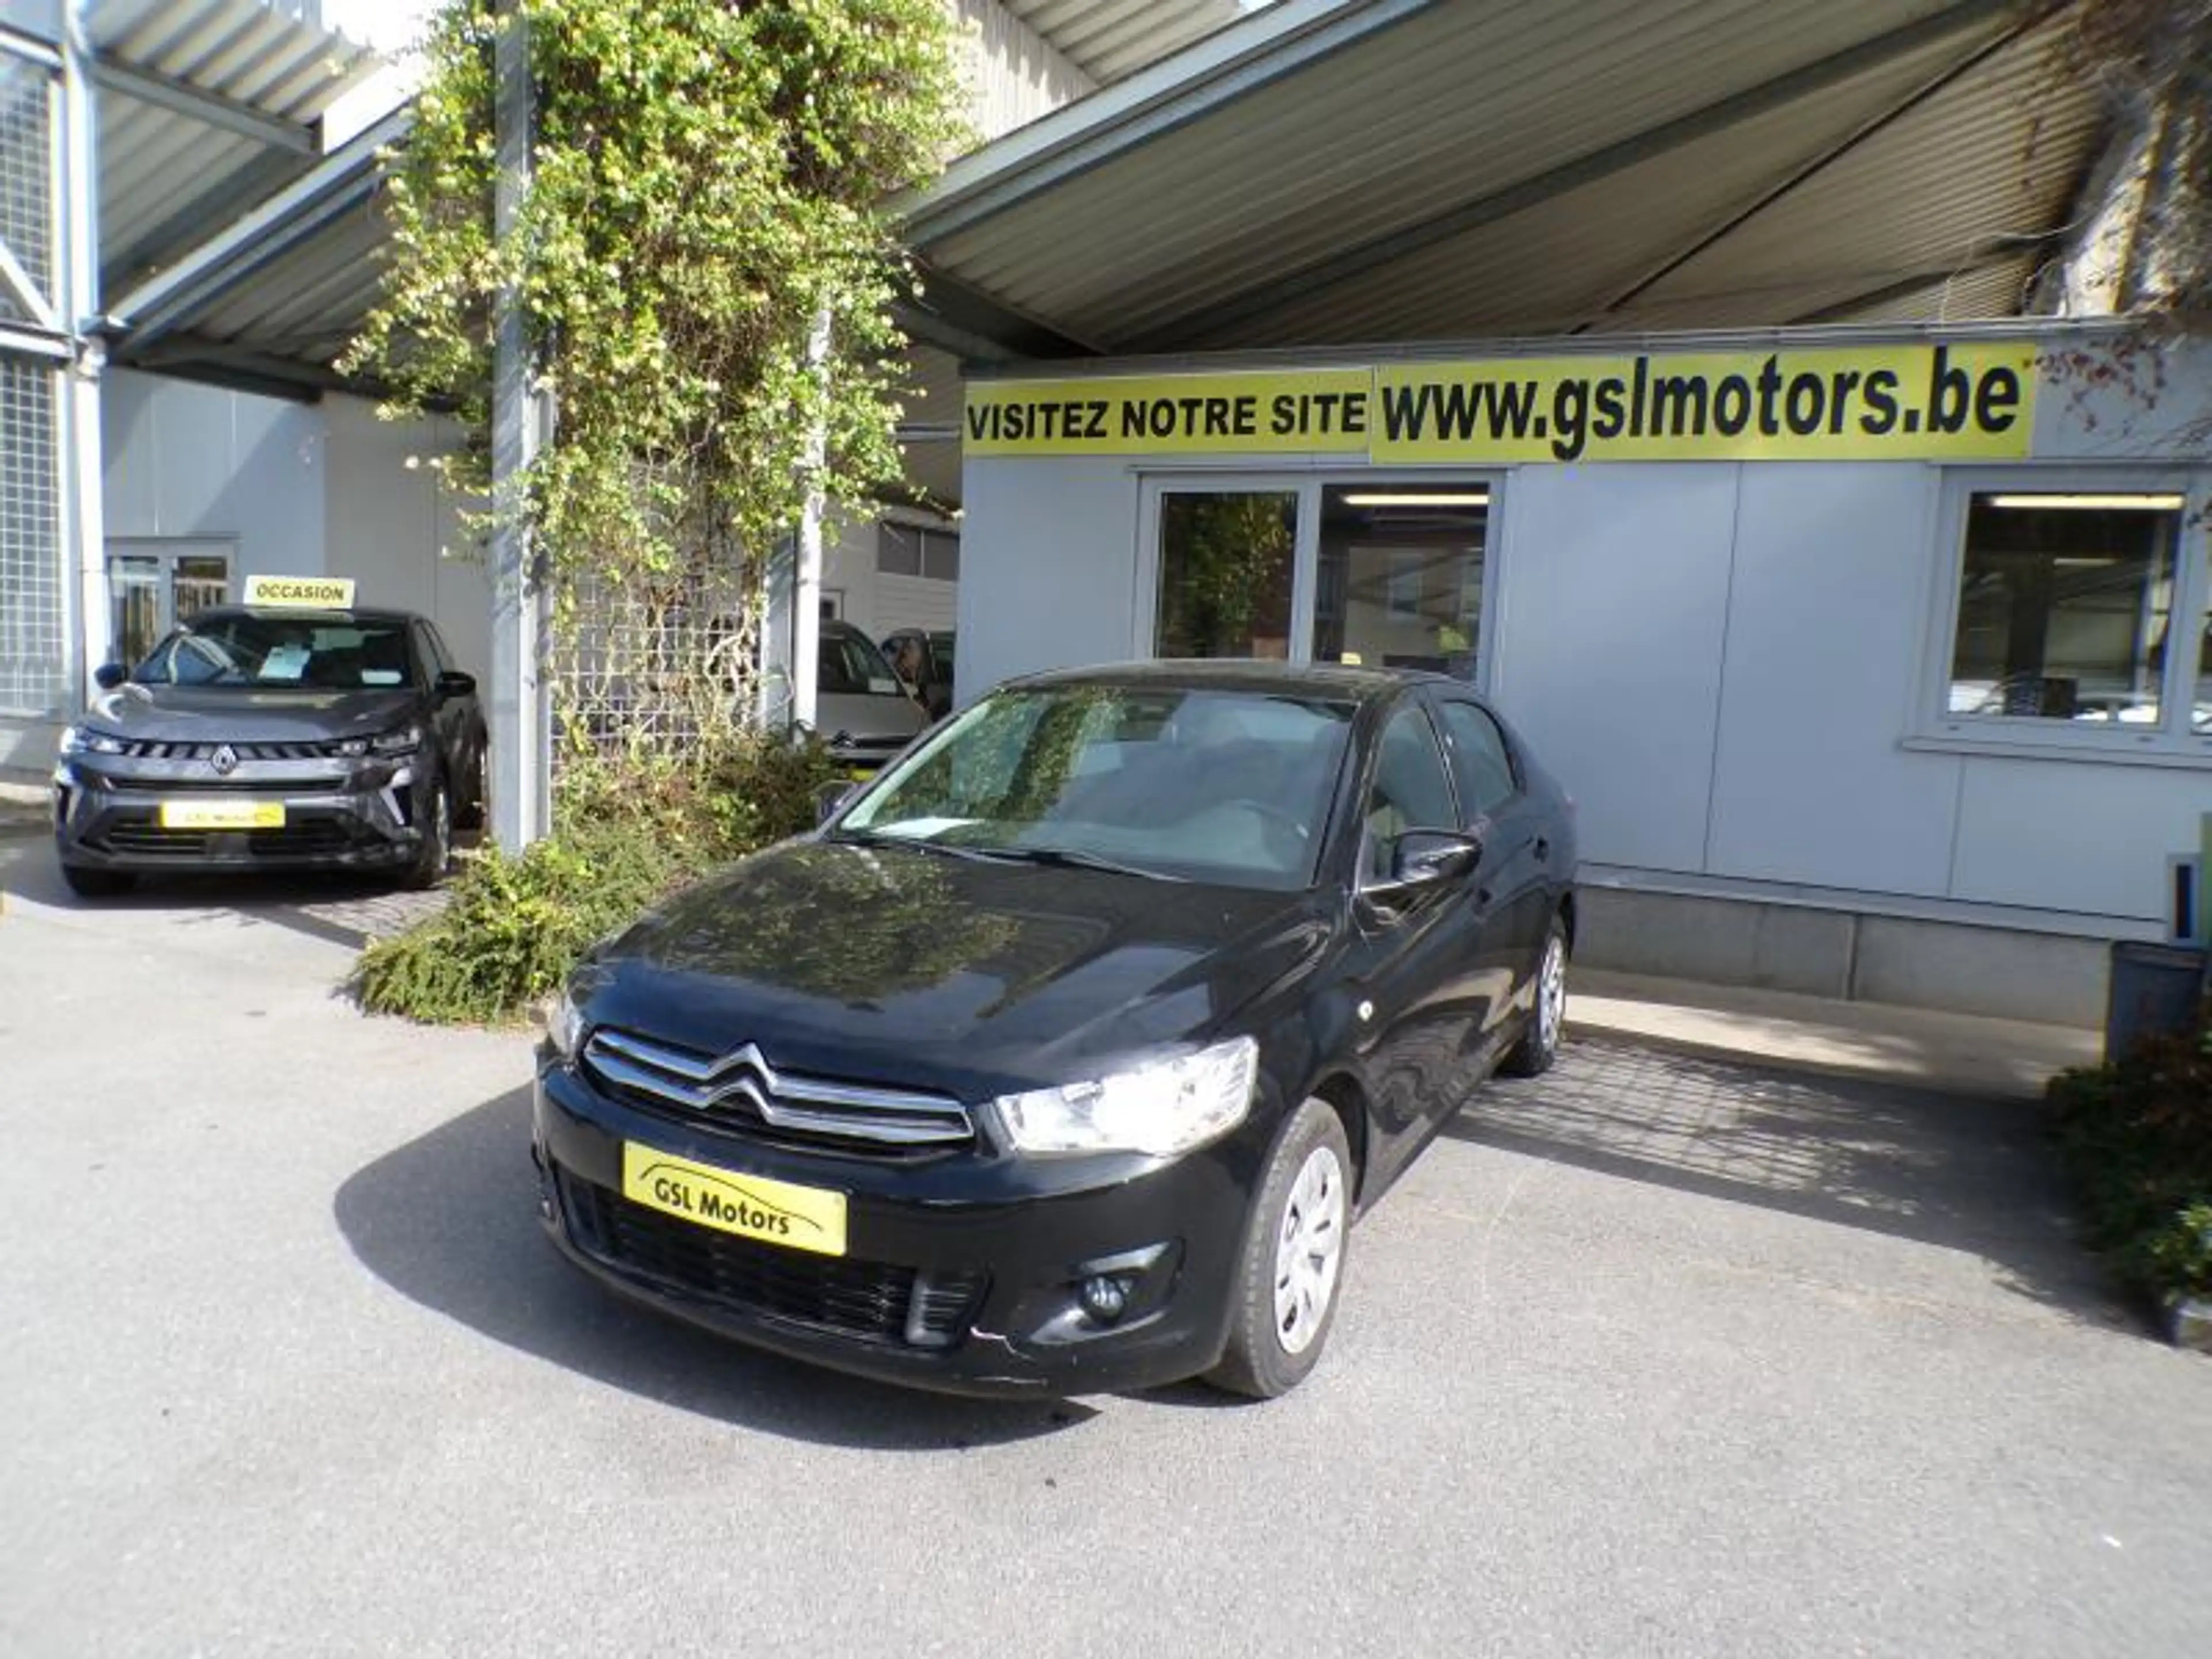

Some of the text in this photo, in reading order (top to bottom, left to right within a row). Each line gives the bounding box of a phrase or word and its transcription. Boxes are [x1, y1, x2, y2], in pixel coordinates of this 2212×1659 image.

[967, 392, 1367, 440] VISITEZ NOTRE SITE
[1382, 346, 2020, 460] www.gslmotors.be
[256, 583, 344, 600] OCCASION
[654, 1177, 790, 1234] GSL Motors
